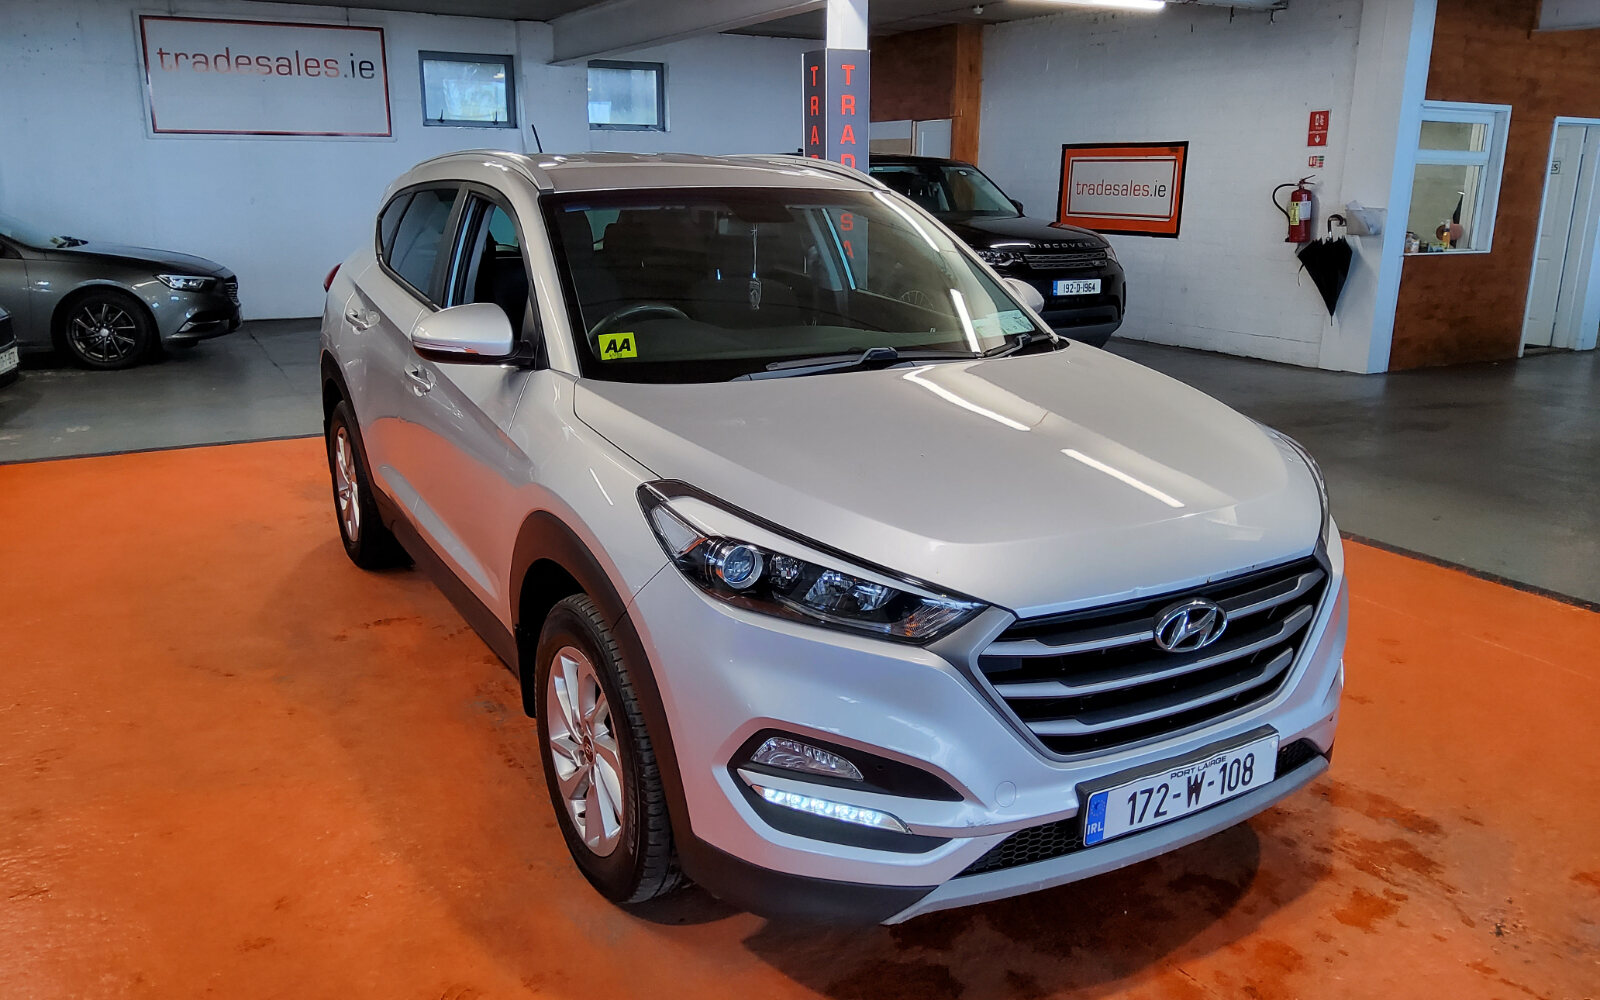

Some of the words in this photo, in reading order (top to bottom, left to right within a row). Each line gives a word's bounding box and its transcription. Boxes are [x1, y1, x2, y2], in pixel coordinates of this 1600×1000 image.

[156, 47, 375, 79] tradesales.ie
[810, 65, 819, 160] TRA
[1076, 179, 1167, 198] tradesales.ie
[604, 338, 631, 354] AA
[1170, 767, 1197, 780] PORT
[1127, 752, 1255, 826] 172-W-108
[1087, 821, 1104, 836] IRL
